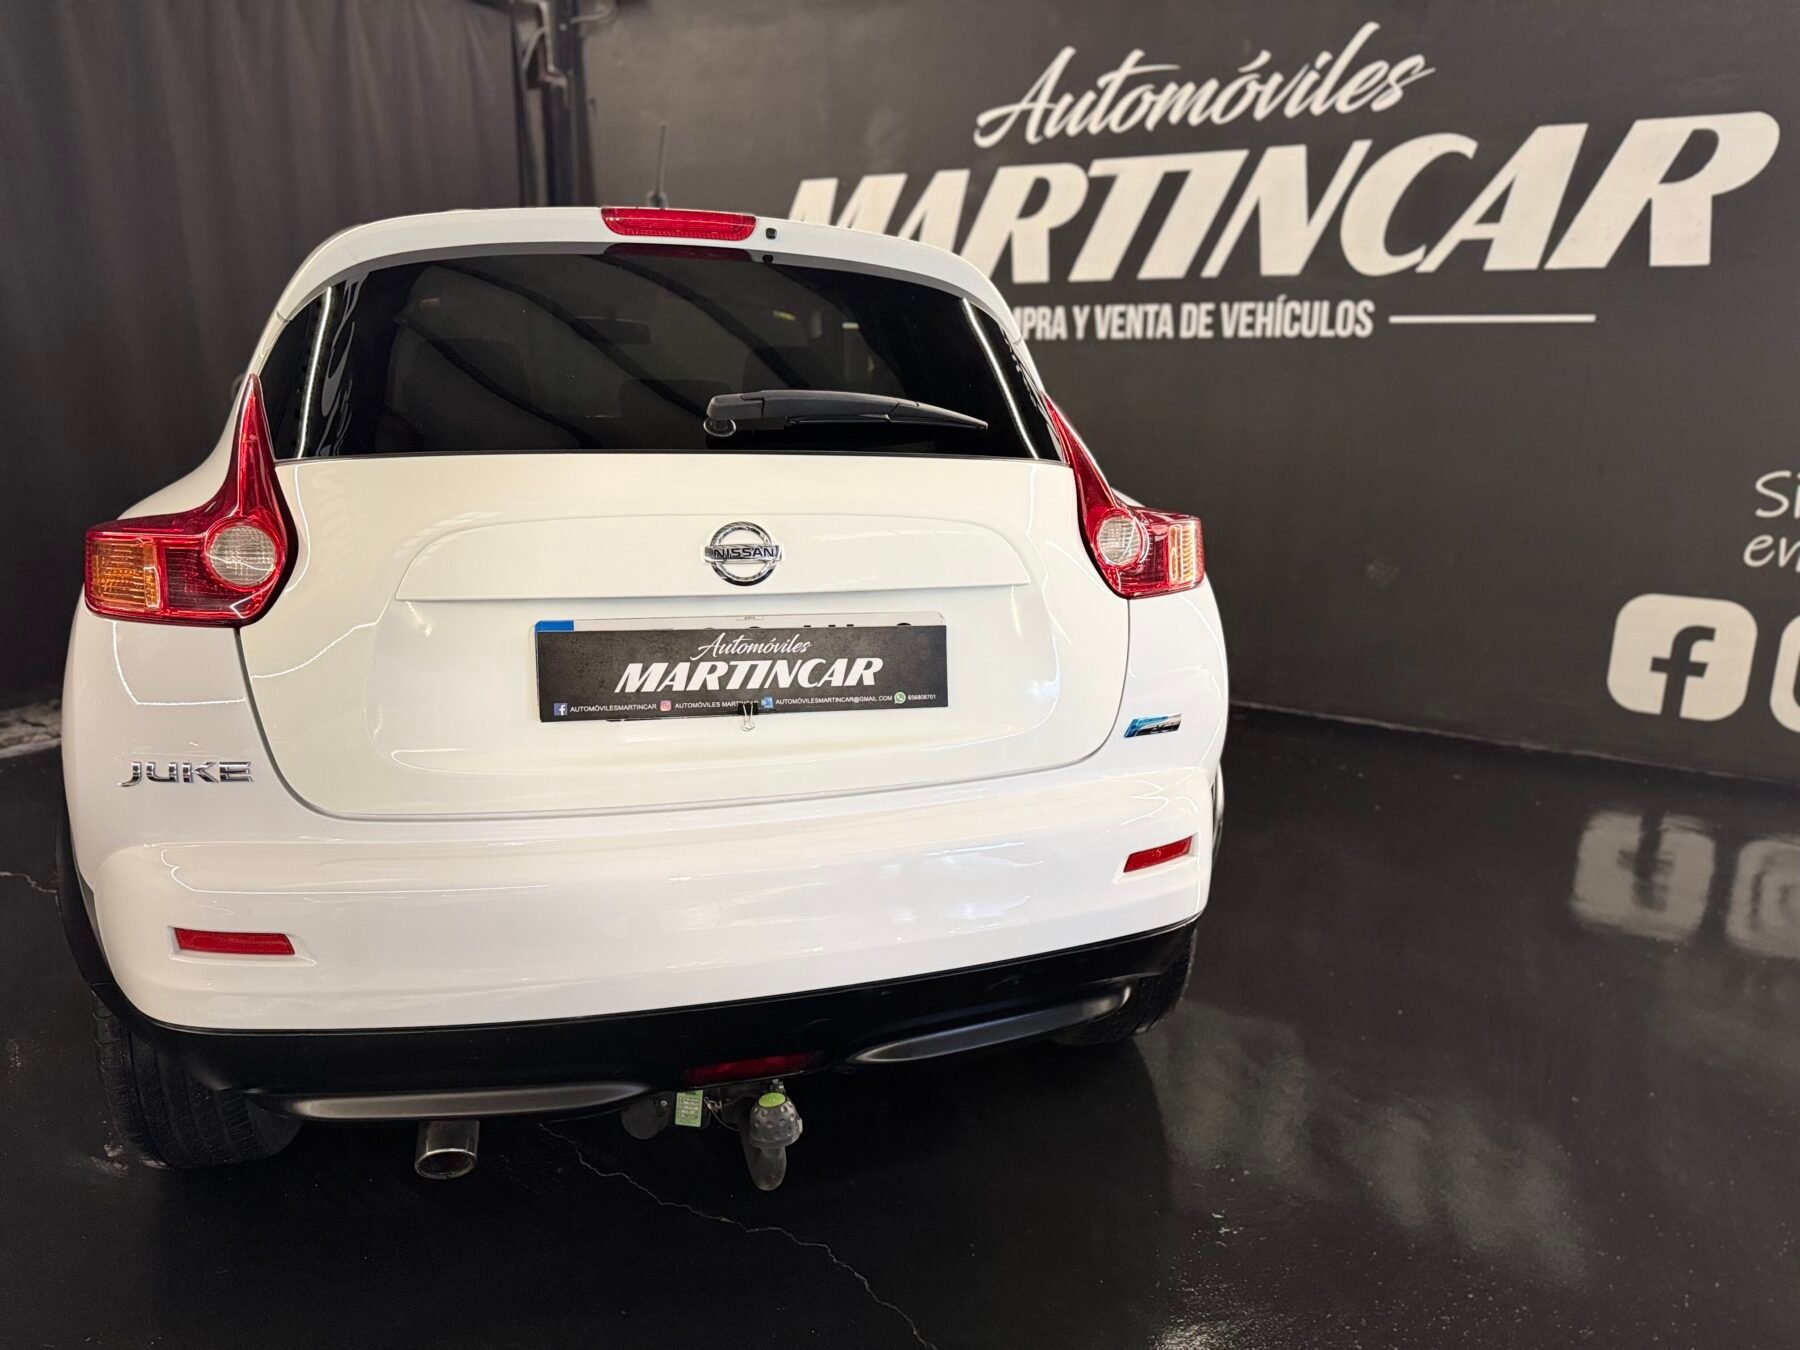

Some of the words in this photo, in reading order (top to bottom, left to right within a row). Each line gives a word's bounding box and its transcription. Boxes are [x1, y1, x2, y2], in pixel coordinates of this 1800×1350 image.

[974, 21, 1437, 148] Automóviles
[1072, 304, 1091, 340] Y
[1094, 302, 1174, 340] VENTA
[1179, 302, 1216, 340] DE
[1221, 294, 1375, 339] VEHÍCULOS
[713, 547, 775, 560] NISSAN
[690, 632, 812, 661] Automóviles
[614, 657, 884, 693] MARTINCAR
[570, 702, 657, 713] AUTOMÓVILESMARTINCAR
[674, 700, 721, 709] AUTOMÓVILES
[117, 760, 254, 788] JUKE
